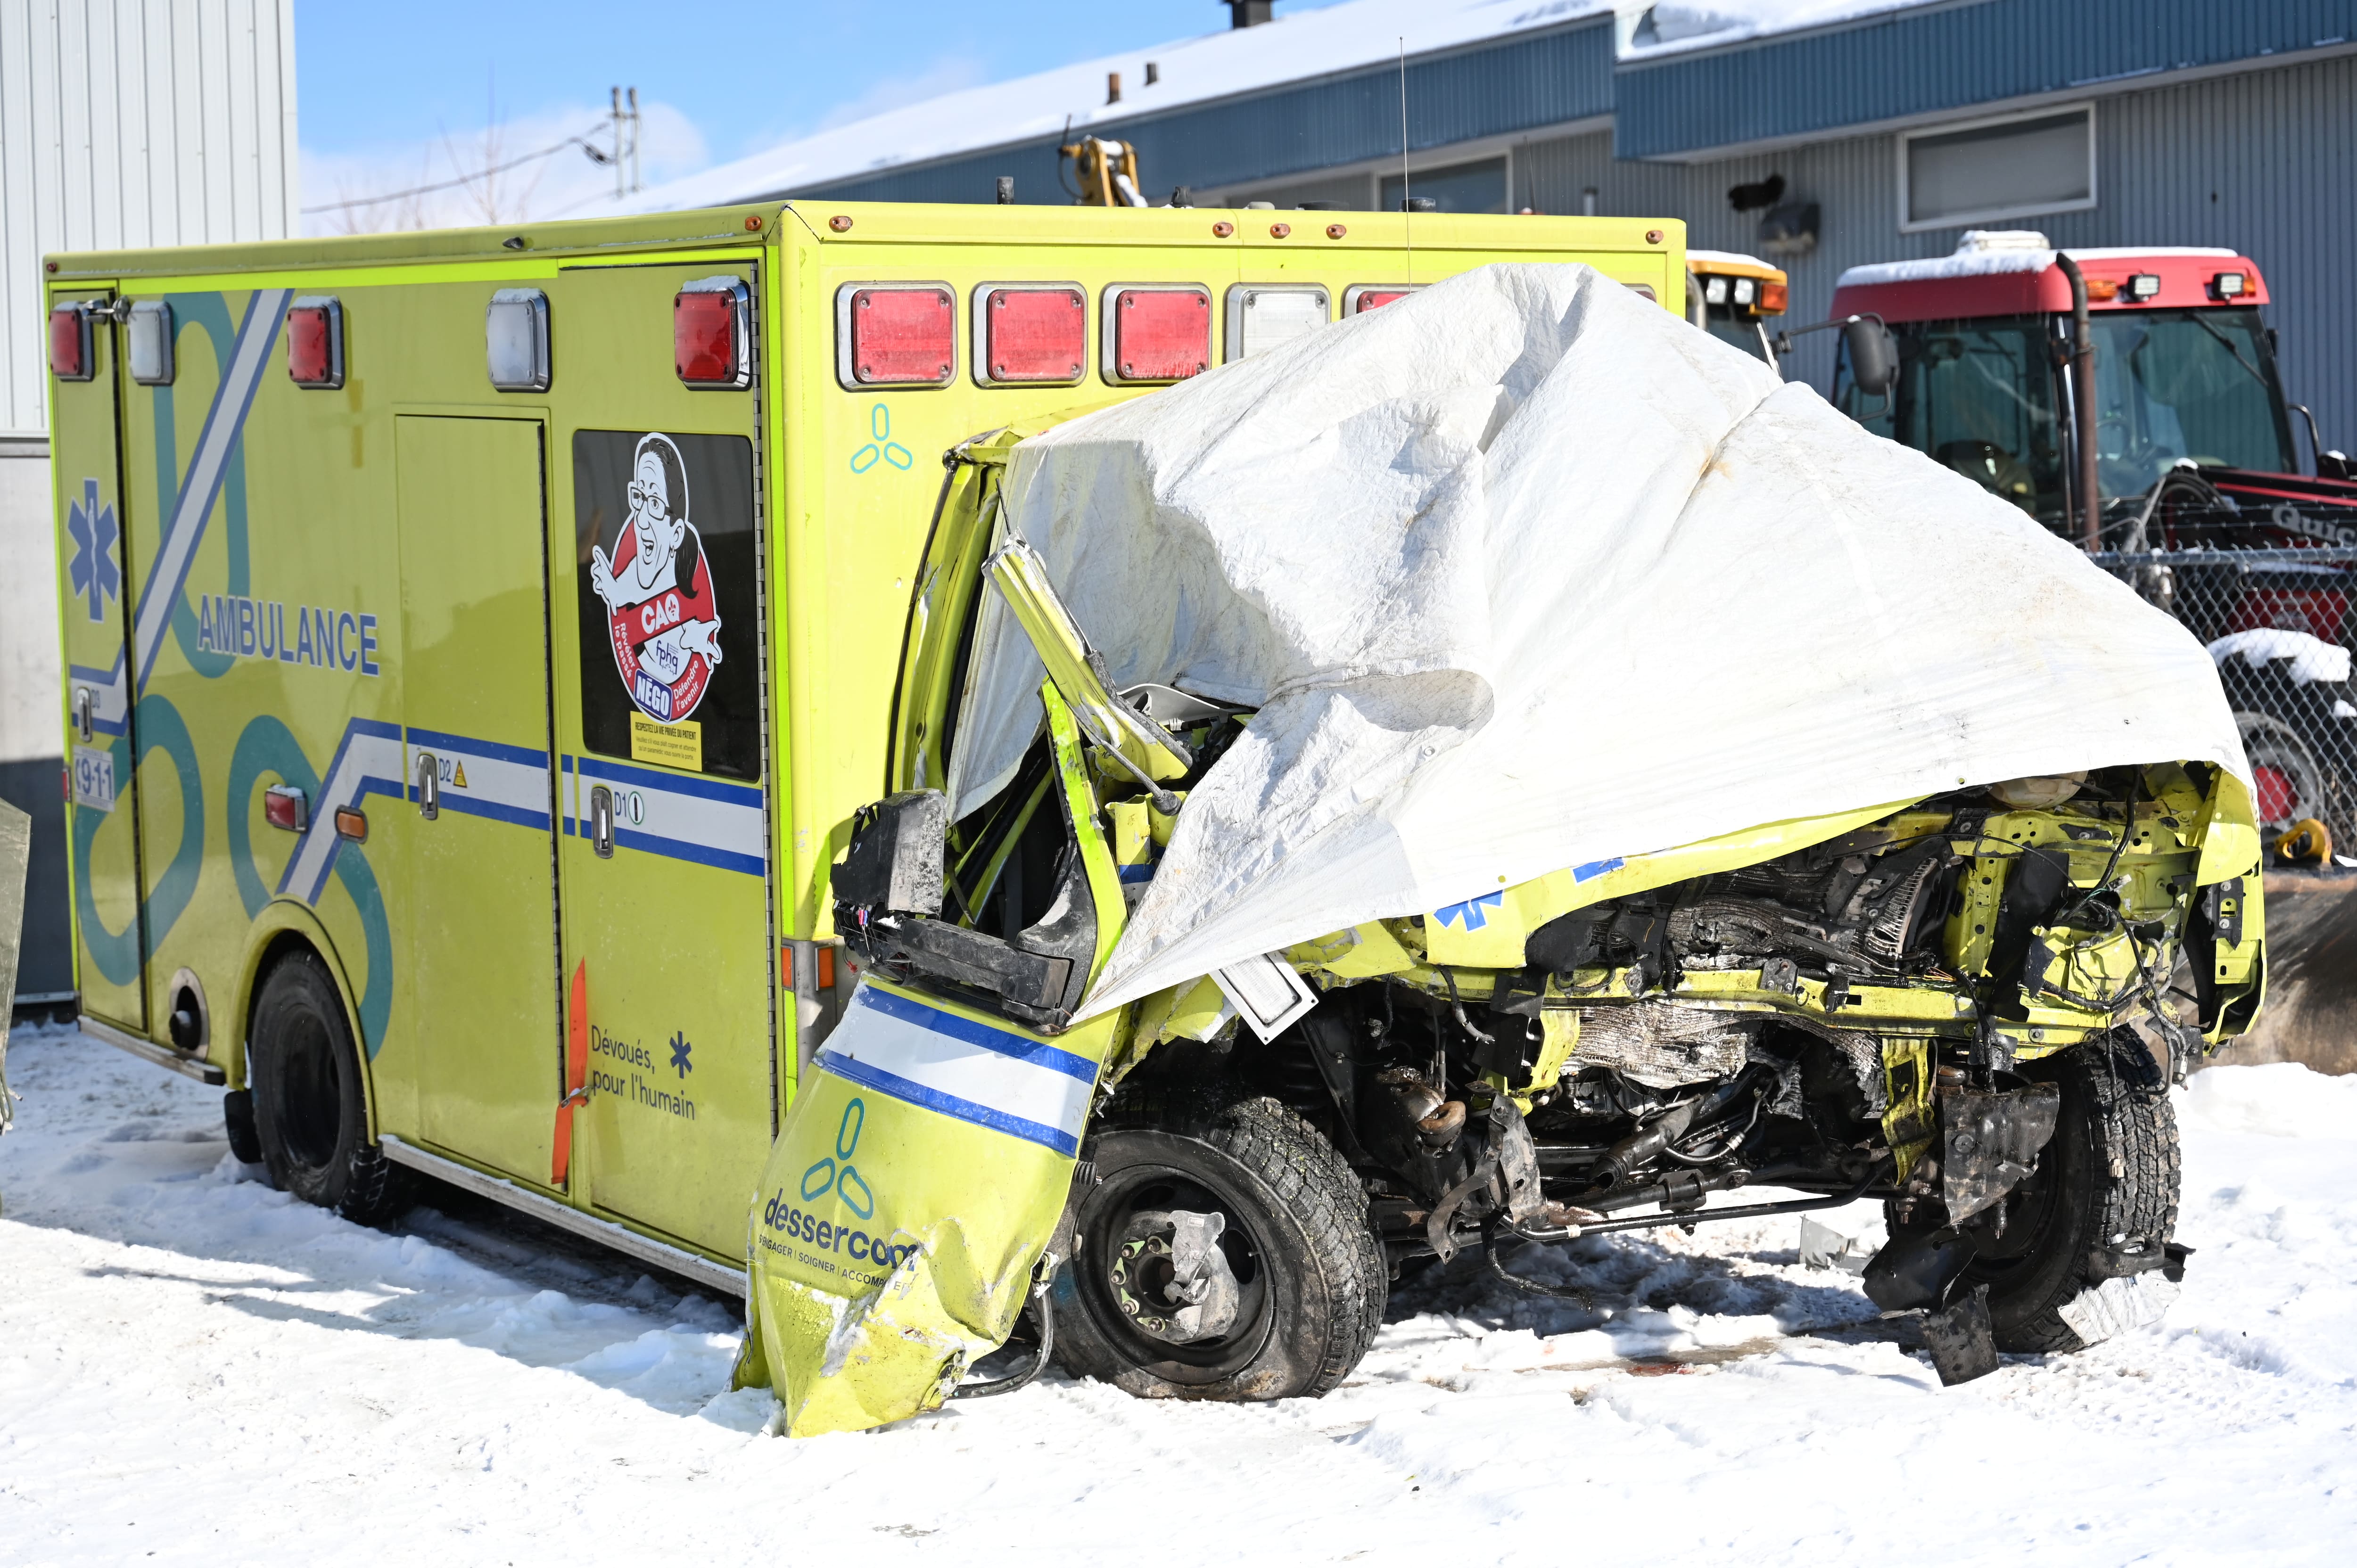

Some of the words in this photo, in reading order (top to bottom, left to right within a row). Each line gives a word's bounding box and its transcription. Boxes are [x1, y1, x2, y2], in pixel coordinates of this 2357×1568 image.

[614, 625, 620, 638] le
[641, 593, 680, 634] CAQ
[197, 593, 379, 677] AMBULANCE
[620, 623, 635, 668] Révéler
[616, 641, 632, 678] passé
[656, 640, 678, 675] fphq
[636, 675, 670, 716] NÉGO
[673, 660, 699, 699] Défendre
[676, 681, 699, 712] l'avenir
[635, 722, 653, 733] RESPECTEZ
[654, 725, 659, 734] LA
[665, 726, 676, 737] PRIVÉE
[677, 729, 682, 738] DU
[683, 730, 696, 740] PATIENT
[439, 758, 451, 782] D2
[614, 791, 626, 818] D1
[592, 1024, 655, 1075] Dévoués,
[593, 1070, 626, 1097] pour
[631, 1073, 695, 1120] l'humain
[764, 1187, 918, 1272] dessercom
[758, 1234, 792, 1258] S'ENGAGER
[799, 1252, 835, 1274] SOIGNER
